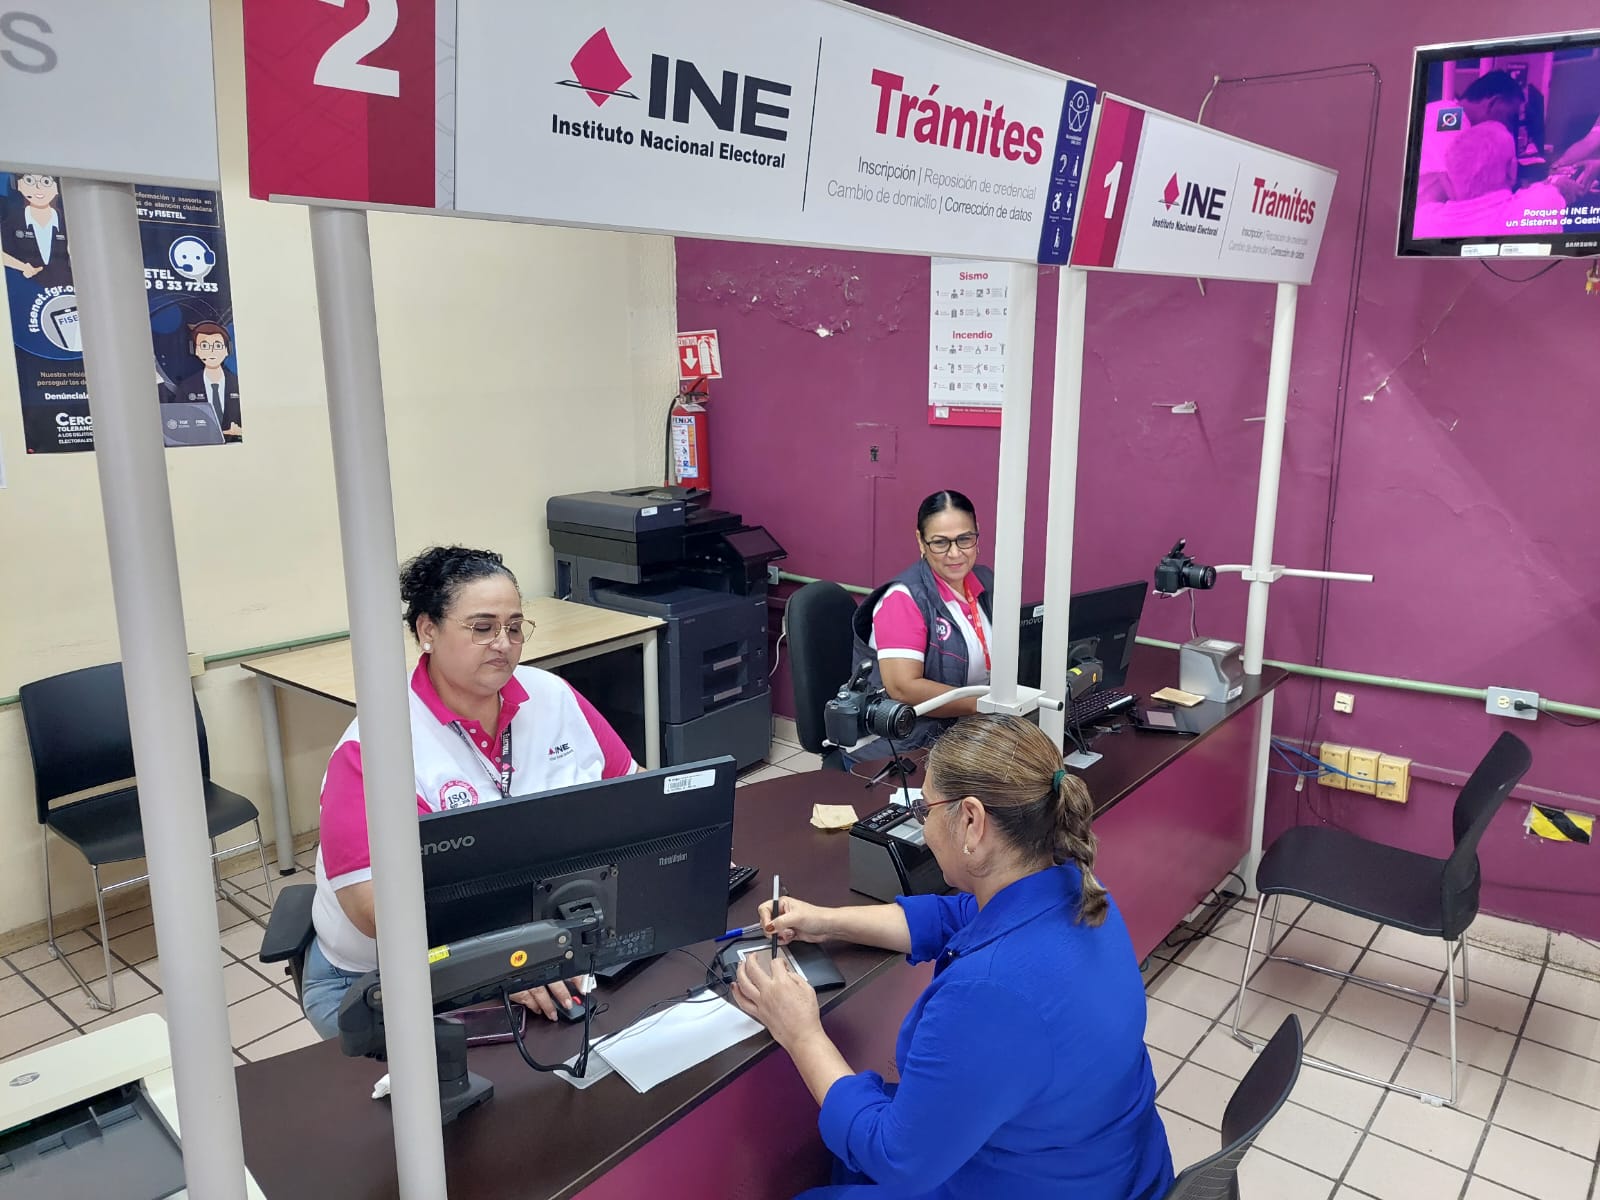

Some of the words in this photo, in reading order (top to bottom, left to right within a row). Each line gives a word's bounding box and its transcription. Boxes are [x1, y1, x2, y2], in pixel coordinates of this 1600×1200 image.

[313, 0, 400, 98] 2
[648, 53, 792, 141] INE
[871, 69, 1044, 165] Trámites
[552, 114, 634, 145] Instituto
[640, 129, 714, 157] Nacional
[719, 143, 786, 169] Electoral
[857, 156, 916, 182] Inscripción
[924, 168, 978, 191] Reposición
[980, 179, 992, 193] de
[993, 183, 1037, 200] credencial
[1103, 161, 1123, 219] 1
[827, 180, 874, 202] Cambio
[876, 188, 890, 204] de
[892, 191, 937, 210] domicilio
[944, 196, 995, 218] Corrección
[996, 206, 1008, 219] de
[1009, 207, 1033, 222] datos
[1181, 182, 1227, 221] INE
[1252, 177, 1316, 225] Trámites
[149, 210, 154, 218] y
[1506, 219, 1519, 228] un
[1520, 218, 1558, 227] Sistema
[1560, 217, 1573, 226] de
[1523, 209, 1558, 218] Porque
[1560, 207, 1569, 216] el
[1571, 206, 1588, 215] INE
[1152, 216, 1174, 230] Instituto
[1175, 220, 1197, 233] Nacional
[1197, 224, 1218, 236] Electoral
[155, 280, 164, 290] 8
[166, 281, 182, 291] 33
[203, 282, 218, 293] 33
[959, 272, 989, 281] Sismo
[952, 330, 993, 340] Incendio
[555, 743, 571, 755] INE
[501, 771, 510, 793] INE
[448, 791, 468, 805] ISO
[421, 835, 476, 856] novo
